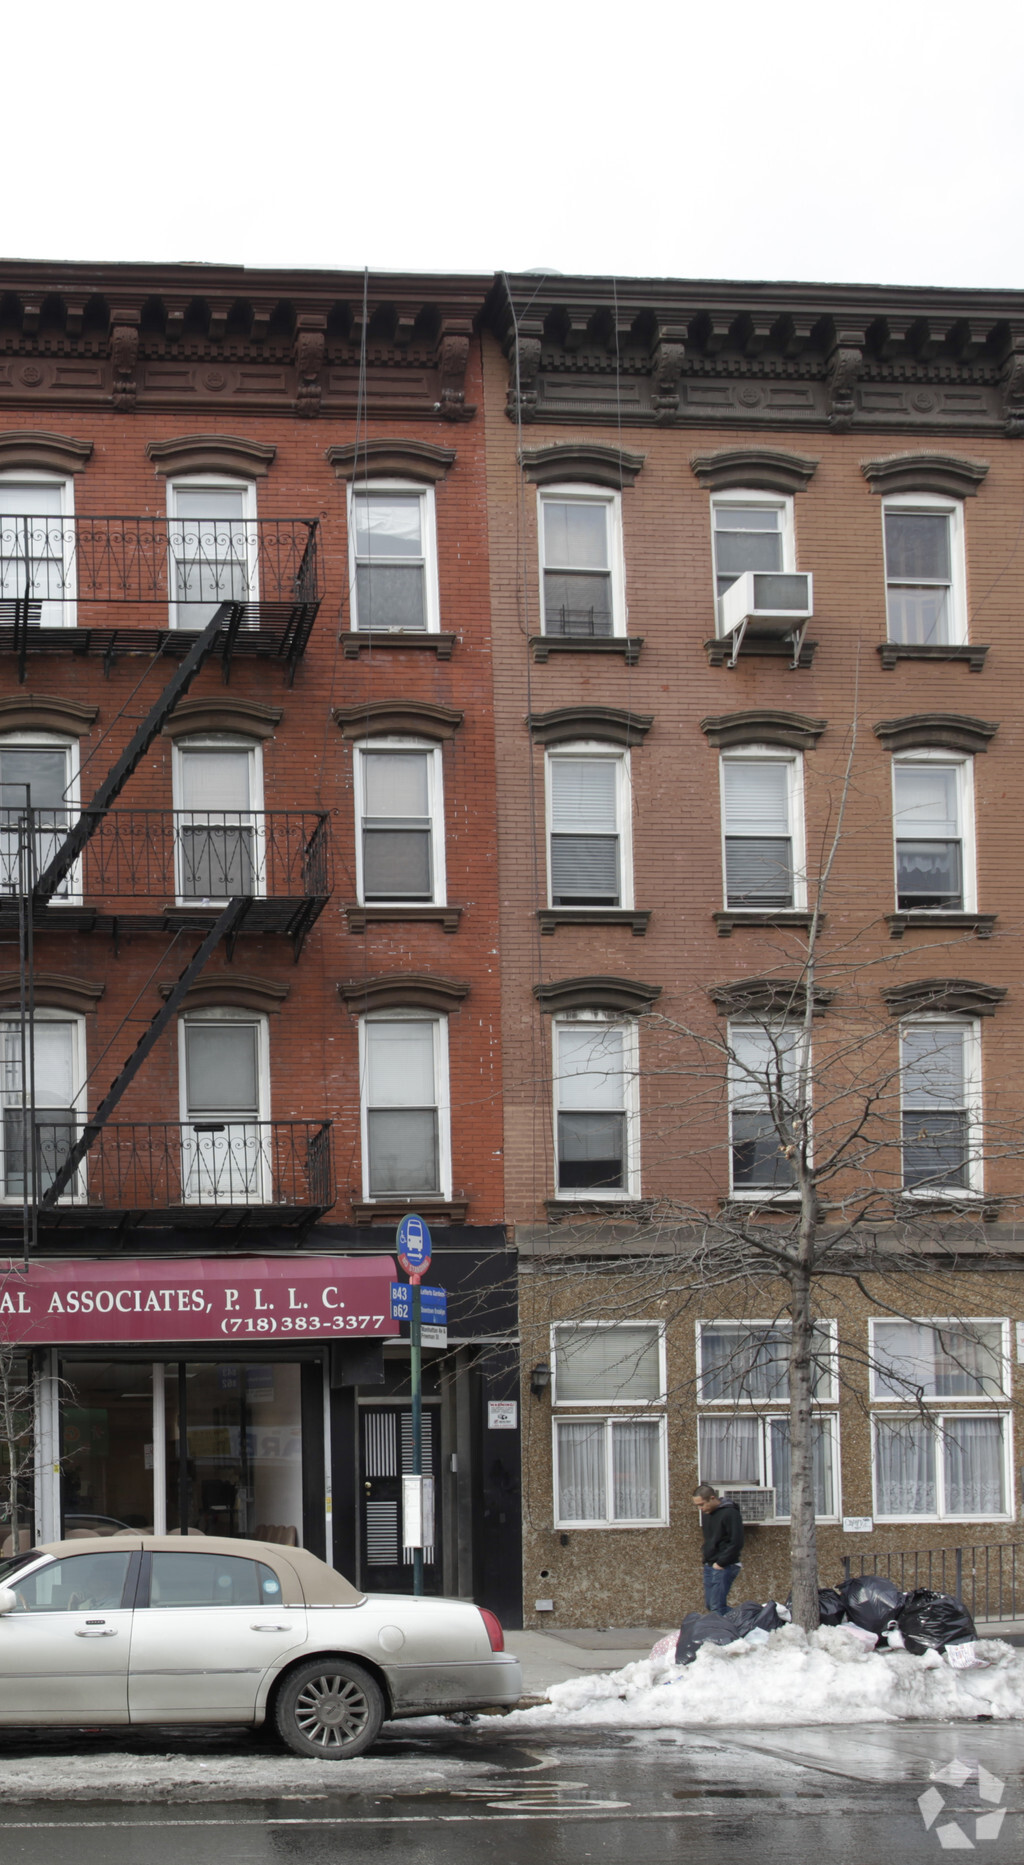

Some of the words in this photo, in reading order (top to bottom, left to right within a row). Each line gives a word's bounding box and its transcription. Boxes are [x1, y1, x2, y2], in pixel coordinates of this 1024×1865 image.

[402, 1257, 408, 1268] NO
[48, 1289, 212, 1314] ASSOCIATES,
[224, 1289, 240, 1310] P.
[254, 1288, 274, 1310] L.
[288, 1288, 308, 1309] L.
[322, 1286, 345, 1308] C.
[392, 1286, 407, 1300] B43
[393, 1304, 408, 1318] B62
